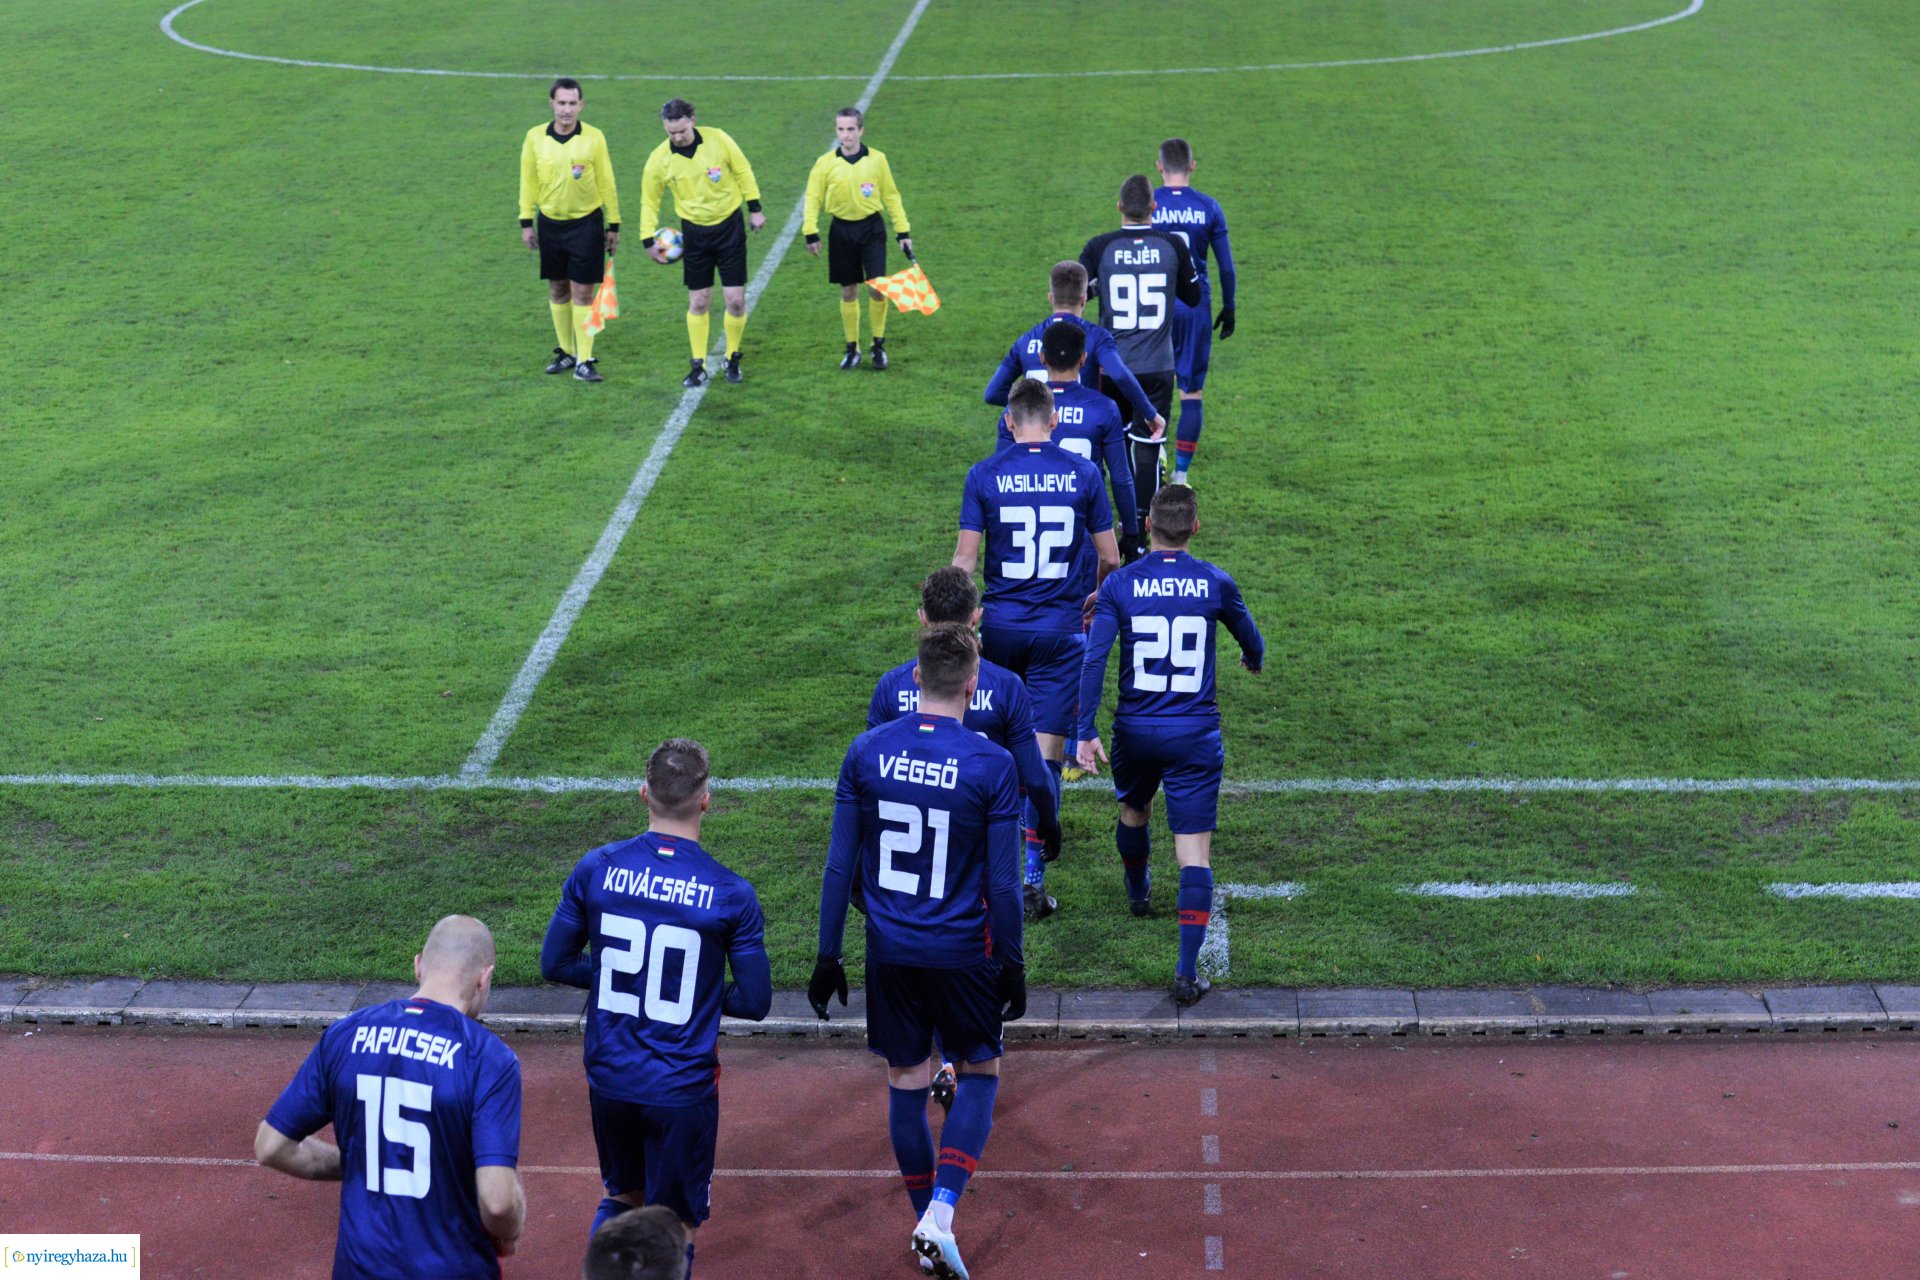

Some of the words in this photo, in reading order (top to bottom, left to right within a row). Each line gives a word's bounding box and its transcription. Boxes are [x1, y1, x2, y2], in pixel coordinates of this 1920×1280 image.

[1114, 245, 1160, 265] FEJÉR
[1109, 273, 1167, 330] 95
[1000, 505, 1076, 580] 32
[1133, 577, 1209, 598] MAGYAR
[1131, 615, 1207, 693] 29
[878, 799, 950, 899] 21
[602, 866, 714, 910] KOVÁCSRÉTI
[597, 912, 702, 1025] 20
[351, 1026, 462, 1070] PAPUCSEK
[356, 1074, 433, 1199] 15
